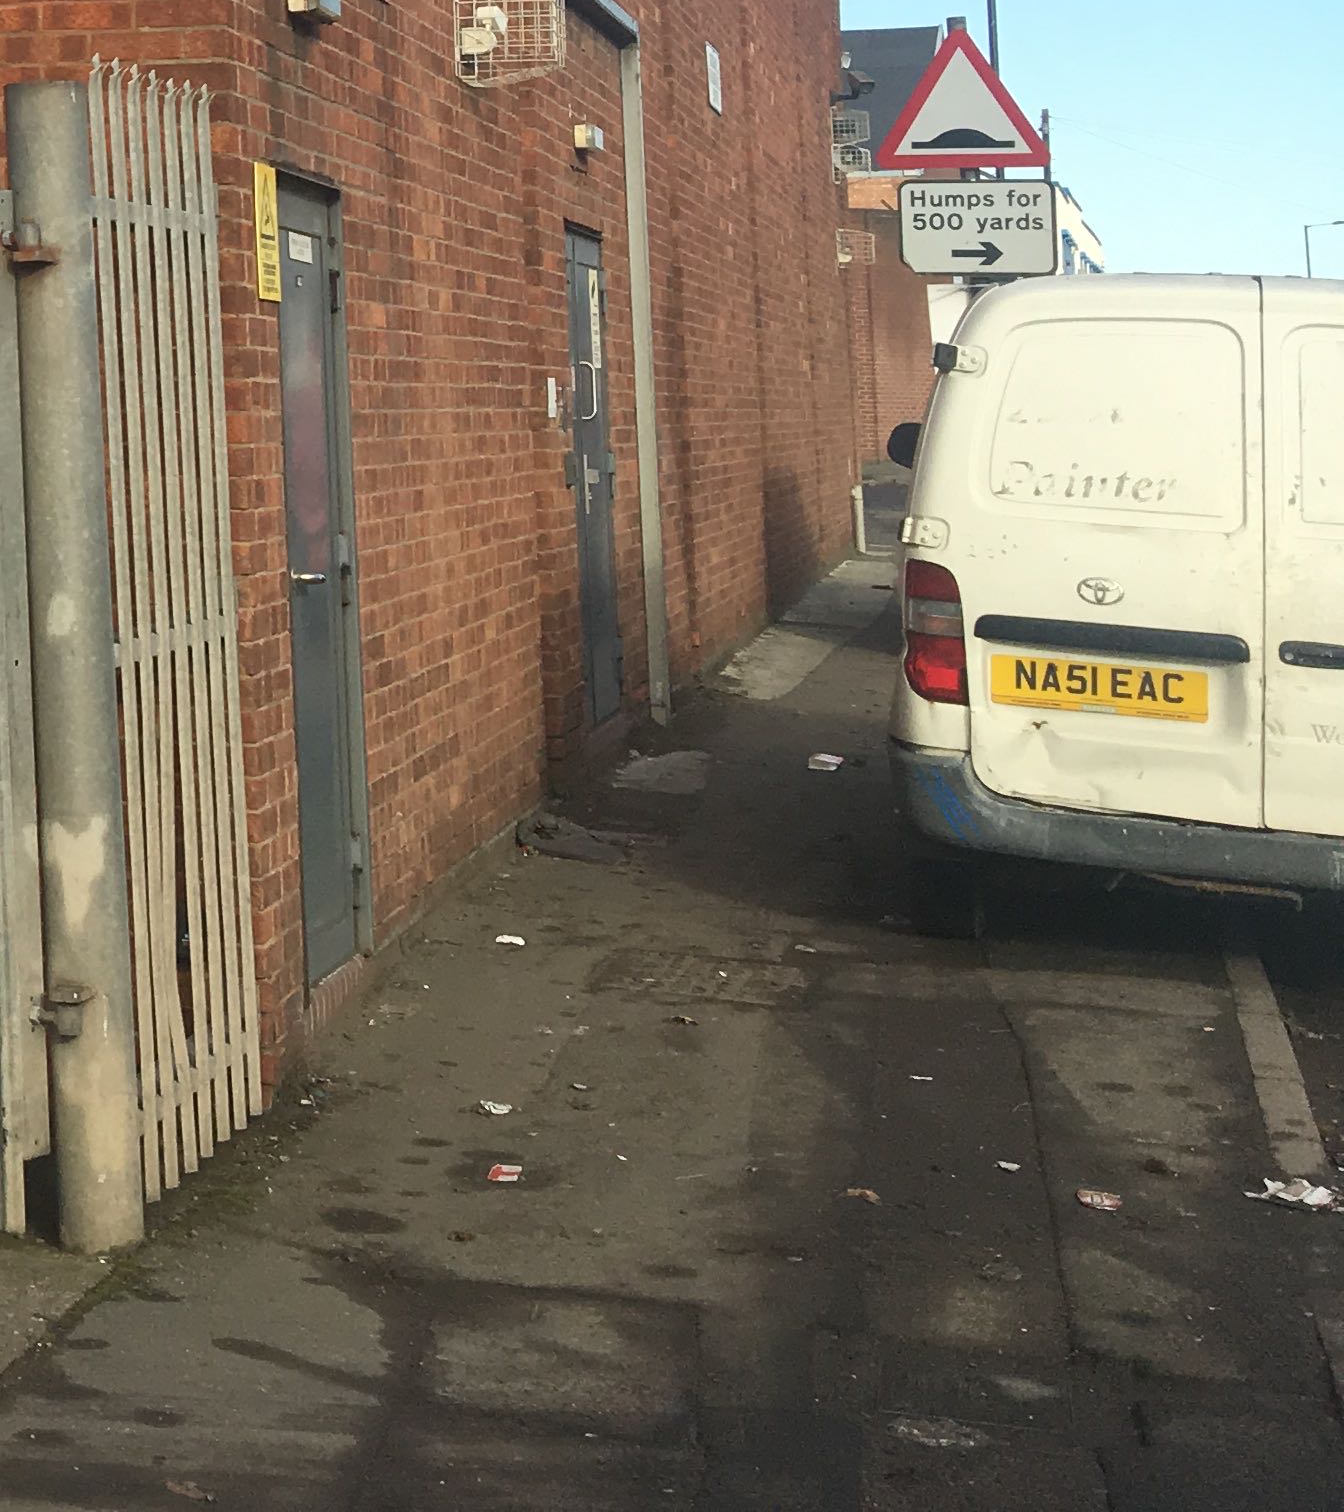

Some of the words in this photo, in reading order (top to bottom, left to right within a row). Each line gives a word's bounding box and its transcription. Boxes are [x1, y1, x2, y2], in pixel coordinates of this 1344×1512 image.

[909, 189, 995, 211] Humps
[1006, 190, 1042, 208] for
[911, 212, 964, 231] 500
[975, 212, 1045, 234] yards
[1015, 659, 1098, 696] NA51
[1111, 668, 1185, 704] EAC
